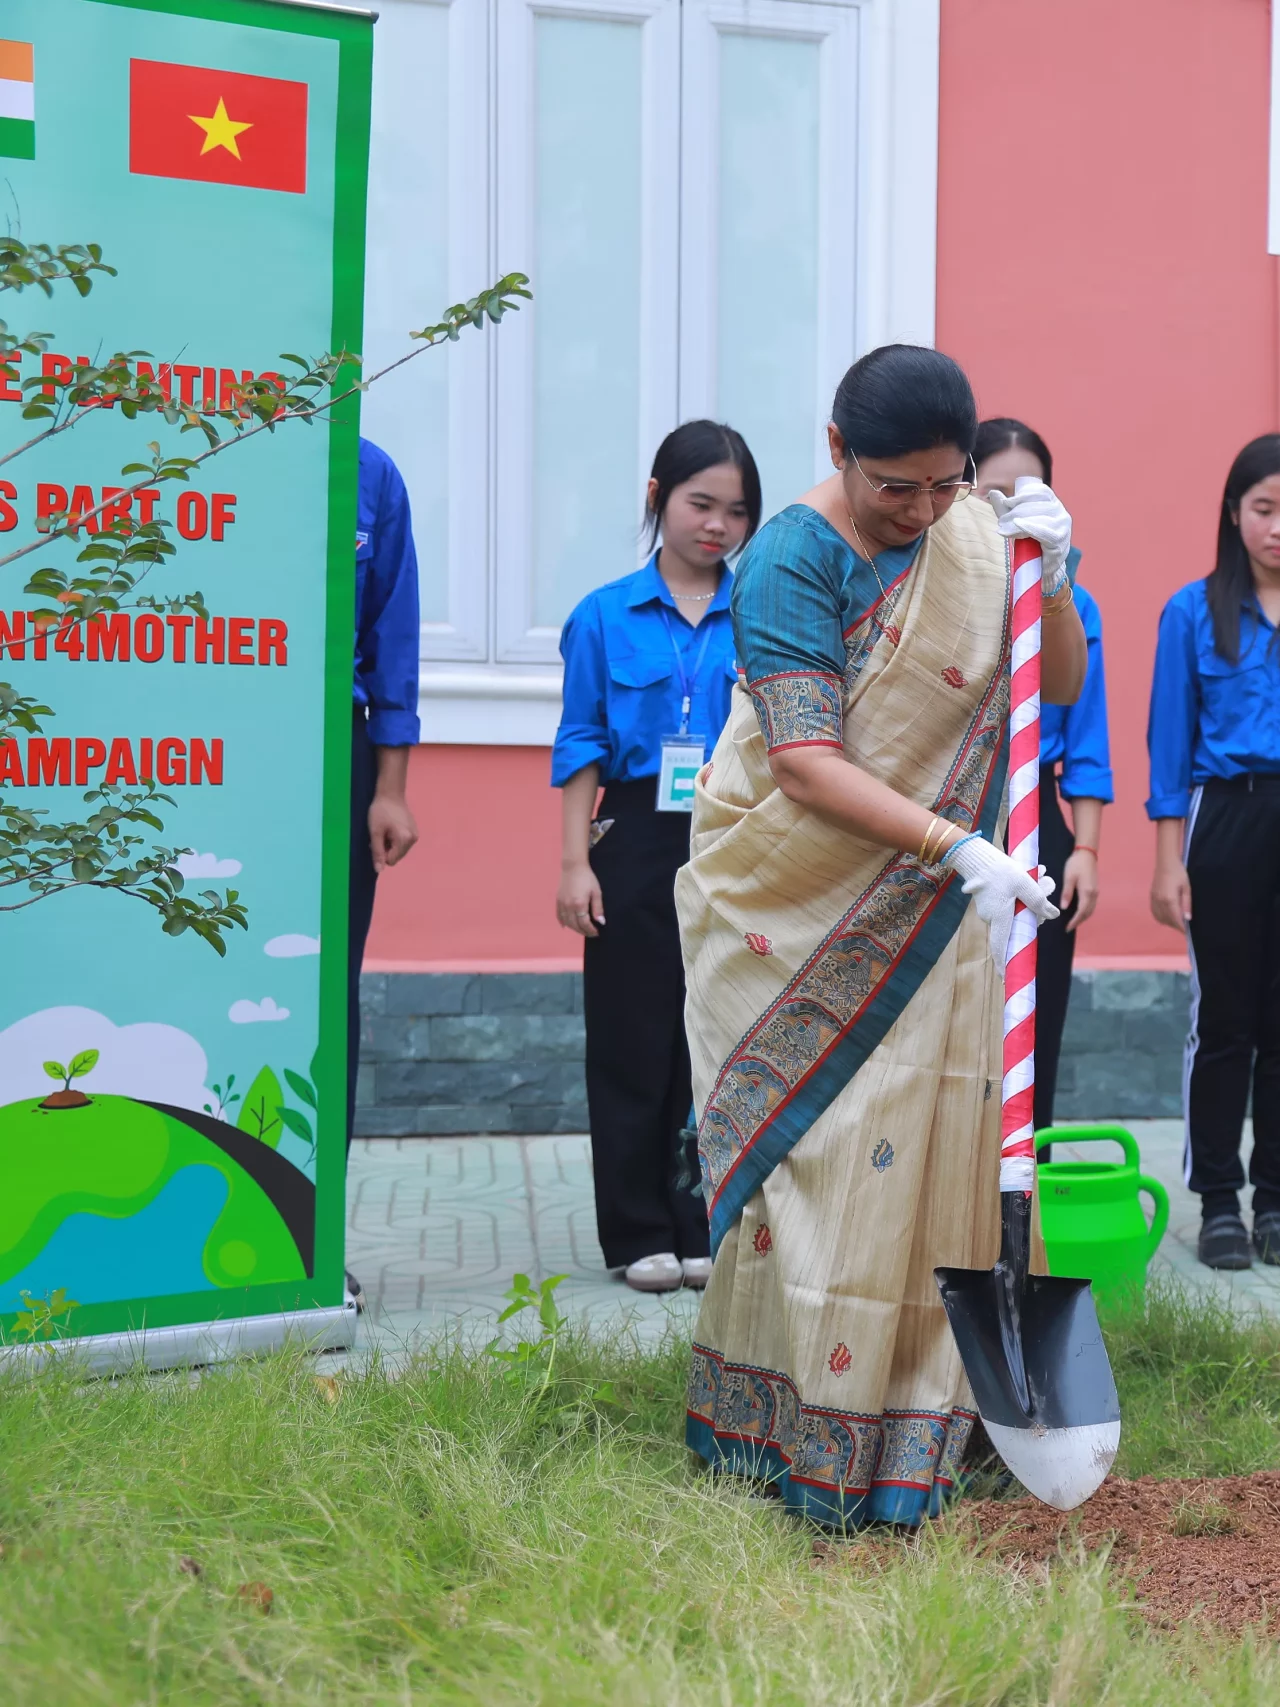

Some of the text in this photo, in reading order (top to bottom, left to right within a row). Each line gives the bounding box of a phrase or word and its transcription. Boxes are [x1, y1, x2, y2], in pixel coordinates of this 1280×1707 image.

[42, 354, 287, 421] PNTIN
[38, 484, 160, 536] PART
[178, 492, 236, 540] OF
